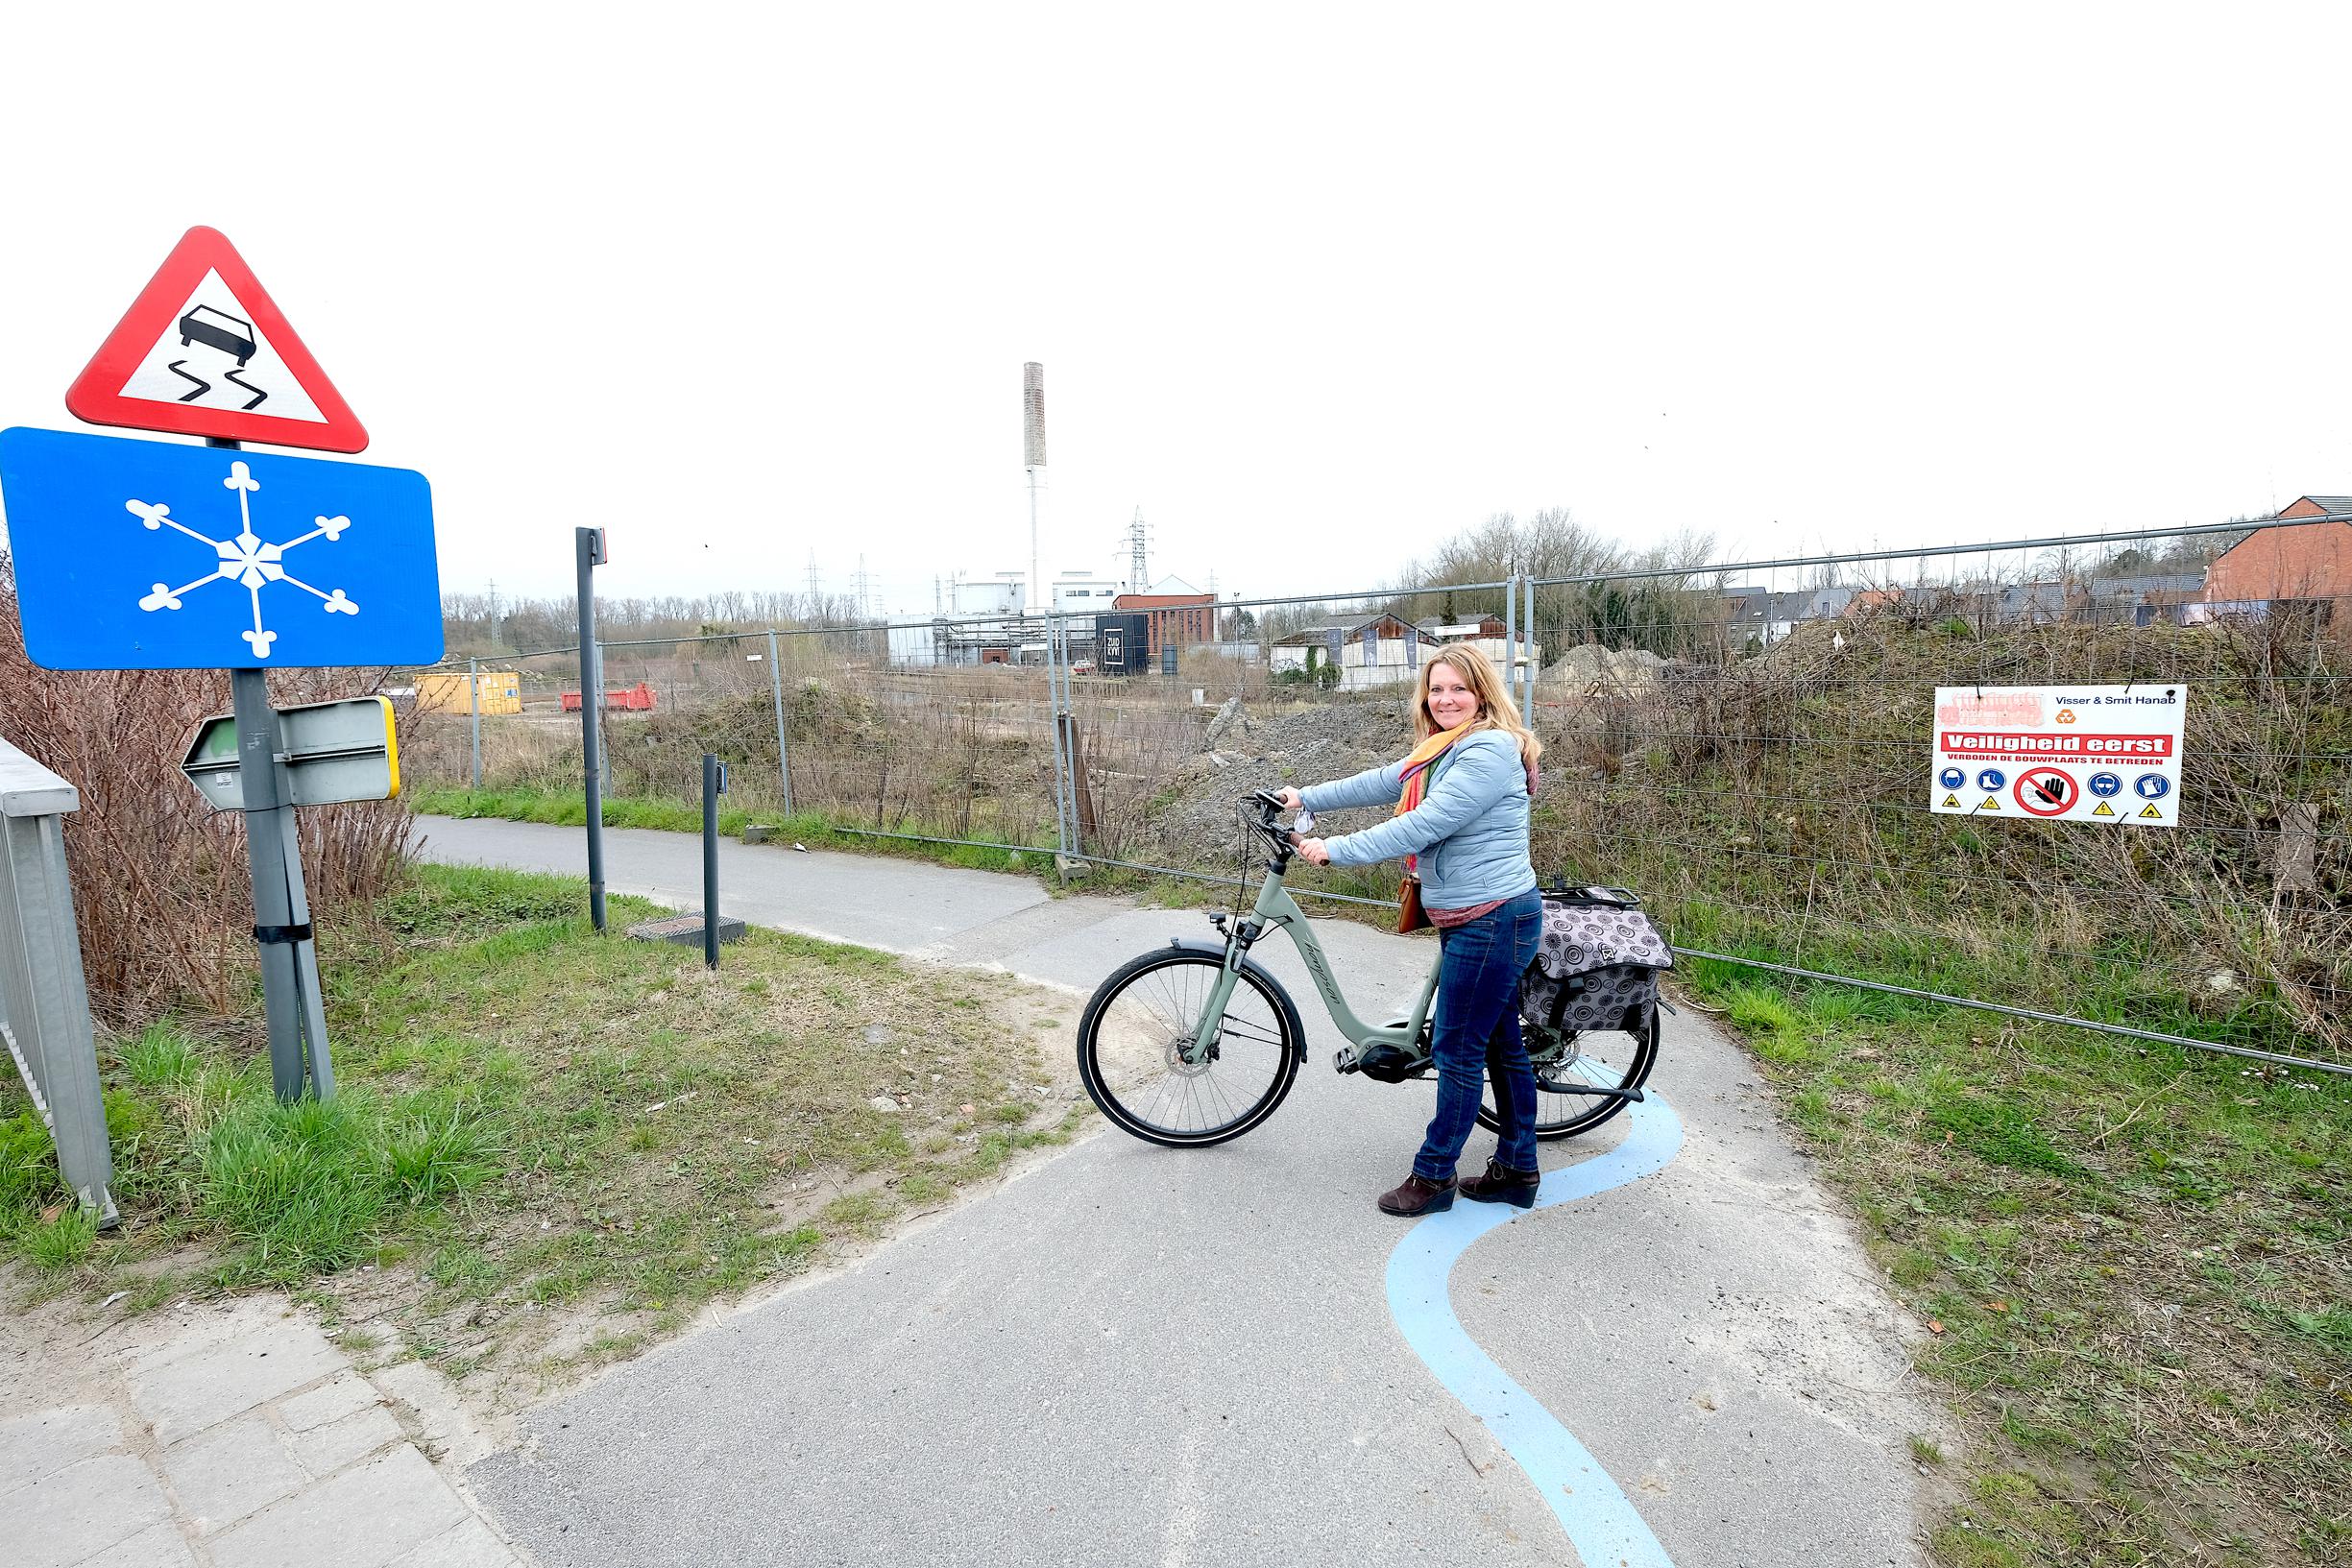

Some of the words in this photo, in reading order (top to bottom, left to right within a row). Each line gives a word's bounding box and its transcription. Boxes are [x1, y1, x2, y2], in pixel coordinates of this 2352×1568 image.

[1106, 637, 1120, 647] ZUID
[2055, 696, 2091, 705] Visser
[2093, 696, 2101, 705] &
[2104, 696, 2132, 705] Smit
[2135, 696, 2176, 705] Hanab
[1947, 735, 2080, 752] Veiligheid
[2086, 737, 2166, 753] eerst
[1947, 753, 1998, 761] VERBODEN
[2015, 756, 2088, 764] BOUWPLAATS
